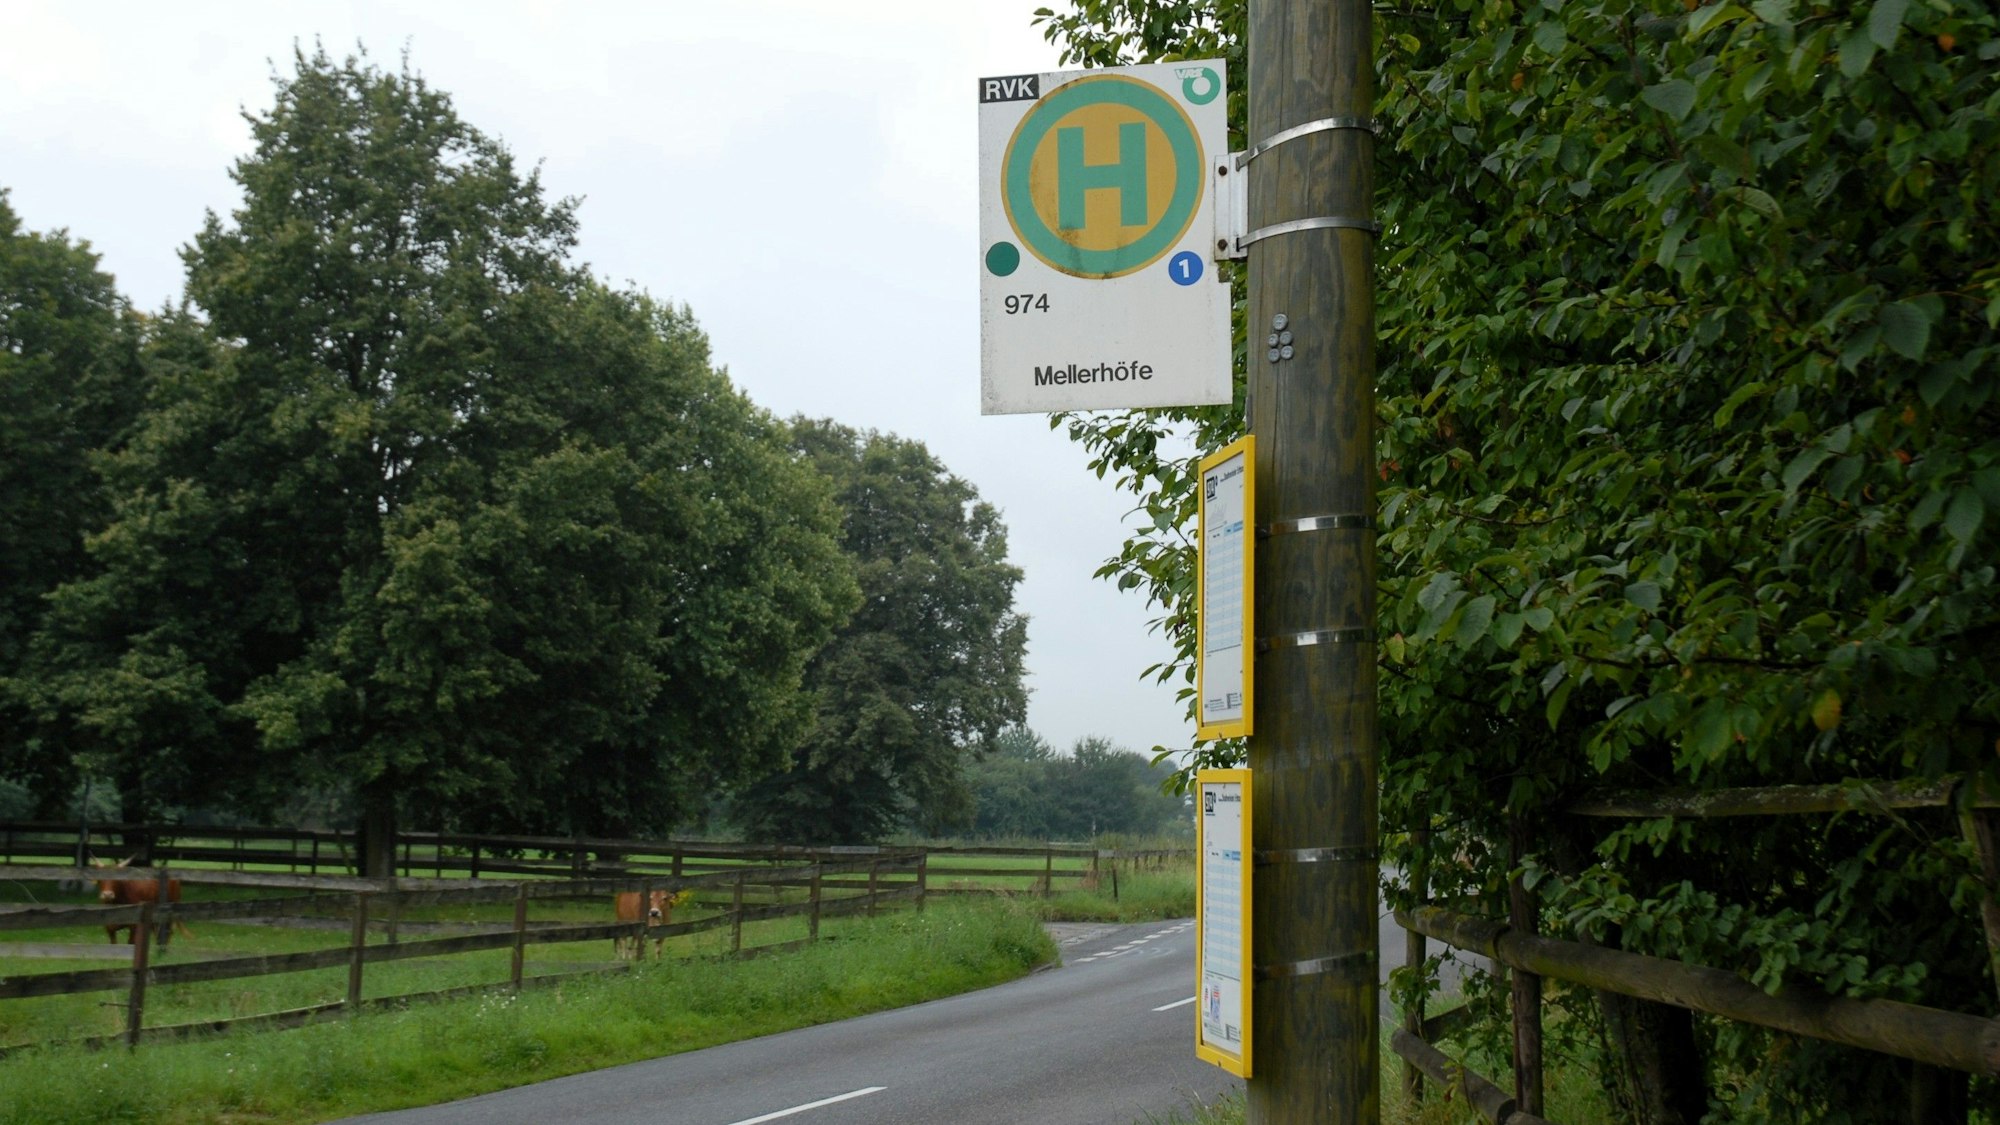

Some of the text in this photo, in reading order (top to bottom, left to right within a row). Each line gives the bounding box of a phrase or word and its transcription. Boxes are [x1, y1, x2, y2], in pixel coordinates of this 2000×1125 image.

[985, 77, 1034, 101] RVK
[1057, 122, 1148, 230] H
[1178, 258, 1191, 278] 1
[1004, 293, 1050, 315] 974
[1034, 361, 1153, 386] Mellerhöfe
